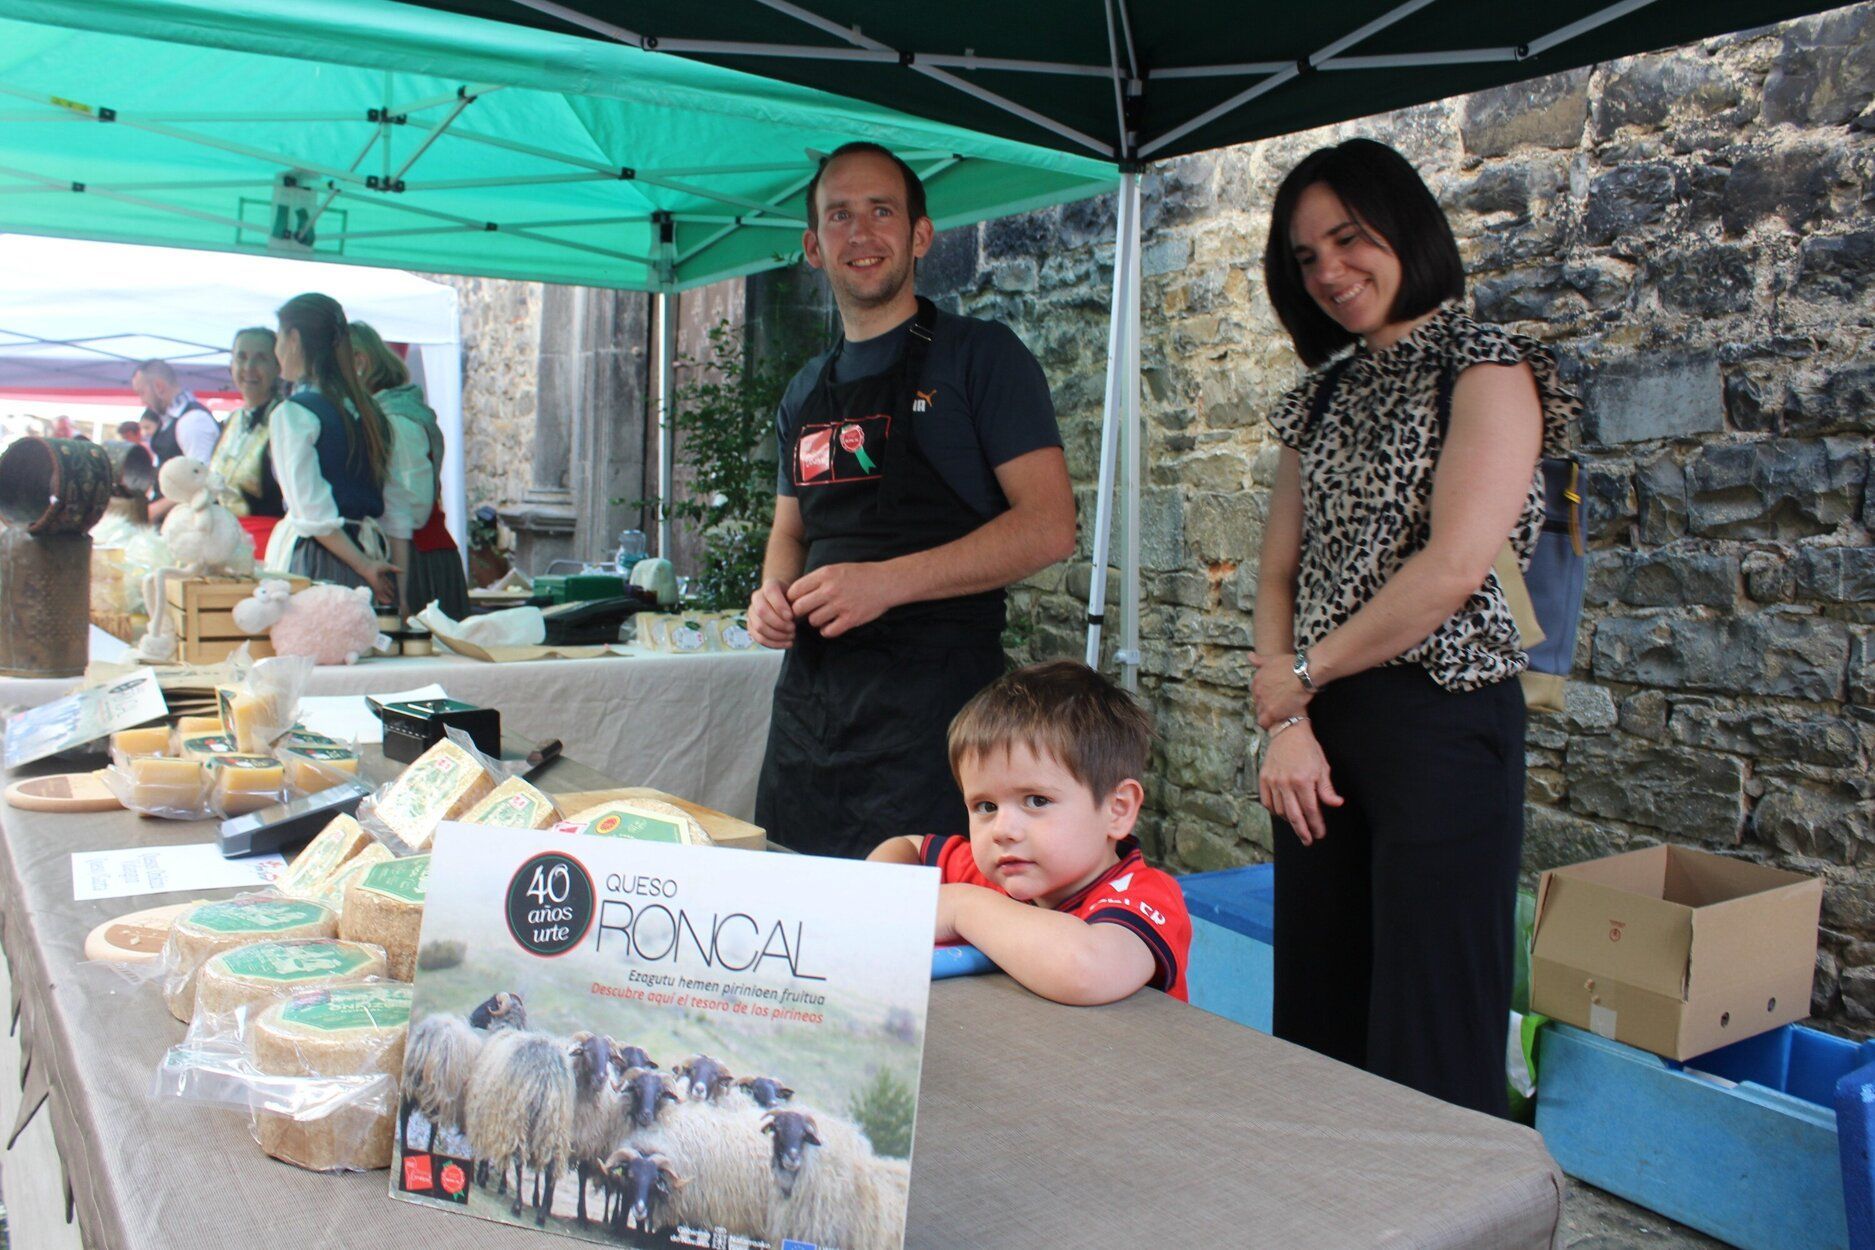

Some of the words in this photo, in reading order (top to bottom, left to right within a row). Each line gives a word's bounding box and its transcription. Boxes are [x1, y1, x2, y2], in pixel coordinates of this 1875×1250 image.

[526, 863, 571, 905] 40
[606, 873, 678, 898] QUESO
[527, 905, 573, 924] años
[533, 924, 570, 943] urte
[596, 899, 827, 981] RONCAL
[591, 983, 645, 1000] Descubre
[647, 992, 675, 1005] aquí
[677, 993, 687, 1006] el
[690, 997, 729, 1011] tesoro
[732, 1000, 748, 1014] de
[750, 1003, 769, 1017] los
[772, 1006, 825, 1023] pirineos
[628, 970, 676, 988] Ezagutu
[678, 976, 719, 992] hemen
[722, 982, 778, 999] pirinioen
[780, 987, 826, 1006] fruitua
